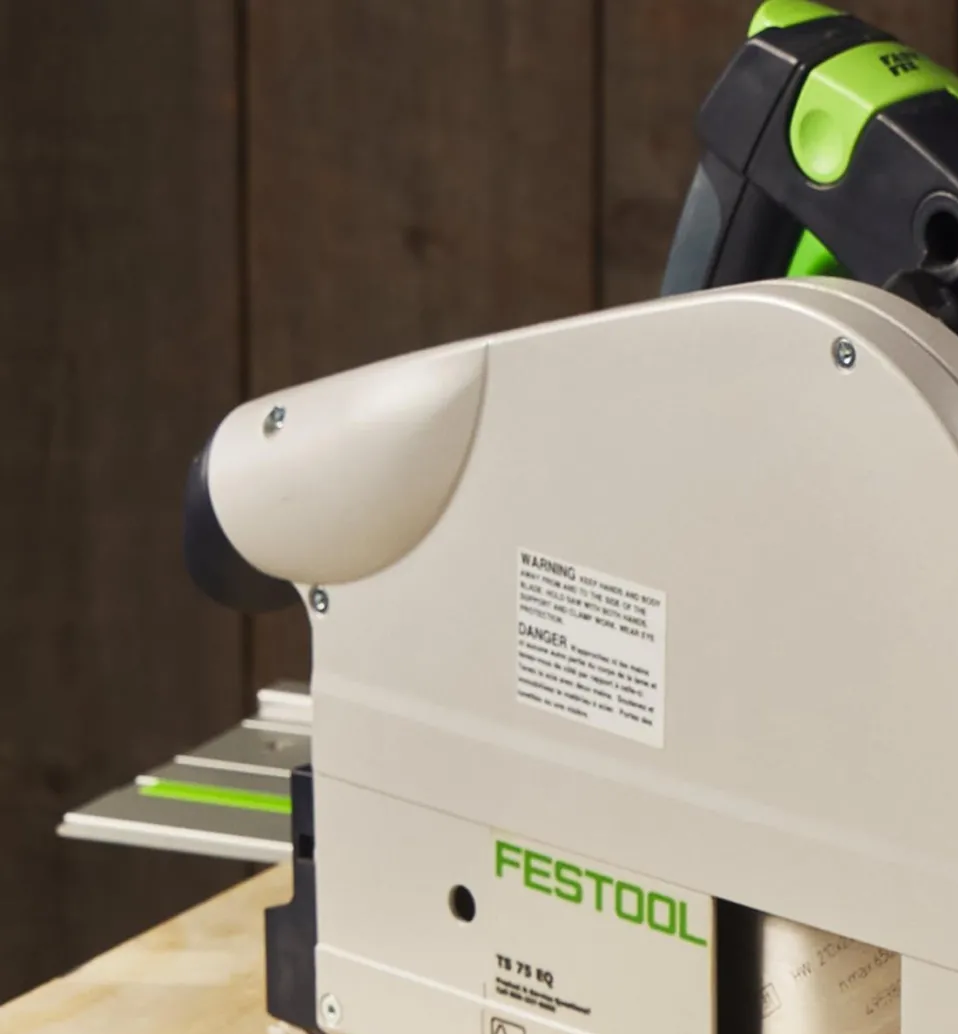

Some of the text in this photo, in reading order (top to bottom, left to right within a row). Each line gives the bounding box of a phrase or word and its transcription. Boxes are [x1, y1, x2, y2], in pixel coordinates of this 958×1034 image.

[520, 551, 575, 581] WARNING
[579, 575, 596, 588] KEEP
[600, 581, 622, 595] HANDS
[641, 594, 660, 607] BODY
[542, 576, 559, 588] FROM
[605, 595, 619, 607] SIDE
[520, 592, 551, 609] SUPPORT
[568, 607, 591, 622] CLAMP
[619, 623, 638, 636] WEAR
[545, 589, 564, 602] HOLD
[584, 600, 599, 613] WITH
[602, 606, 620, 619] BOTH
[518, 621, 566, 649] DANGER
[496, 840, 707, 947] FESTOOL
[496, 953, 554, 990] TS 75 EQ
